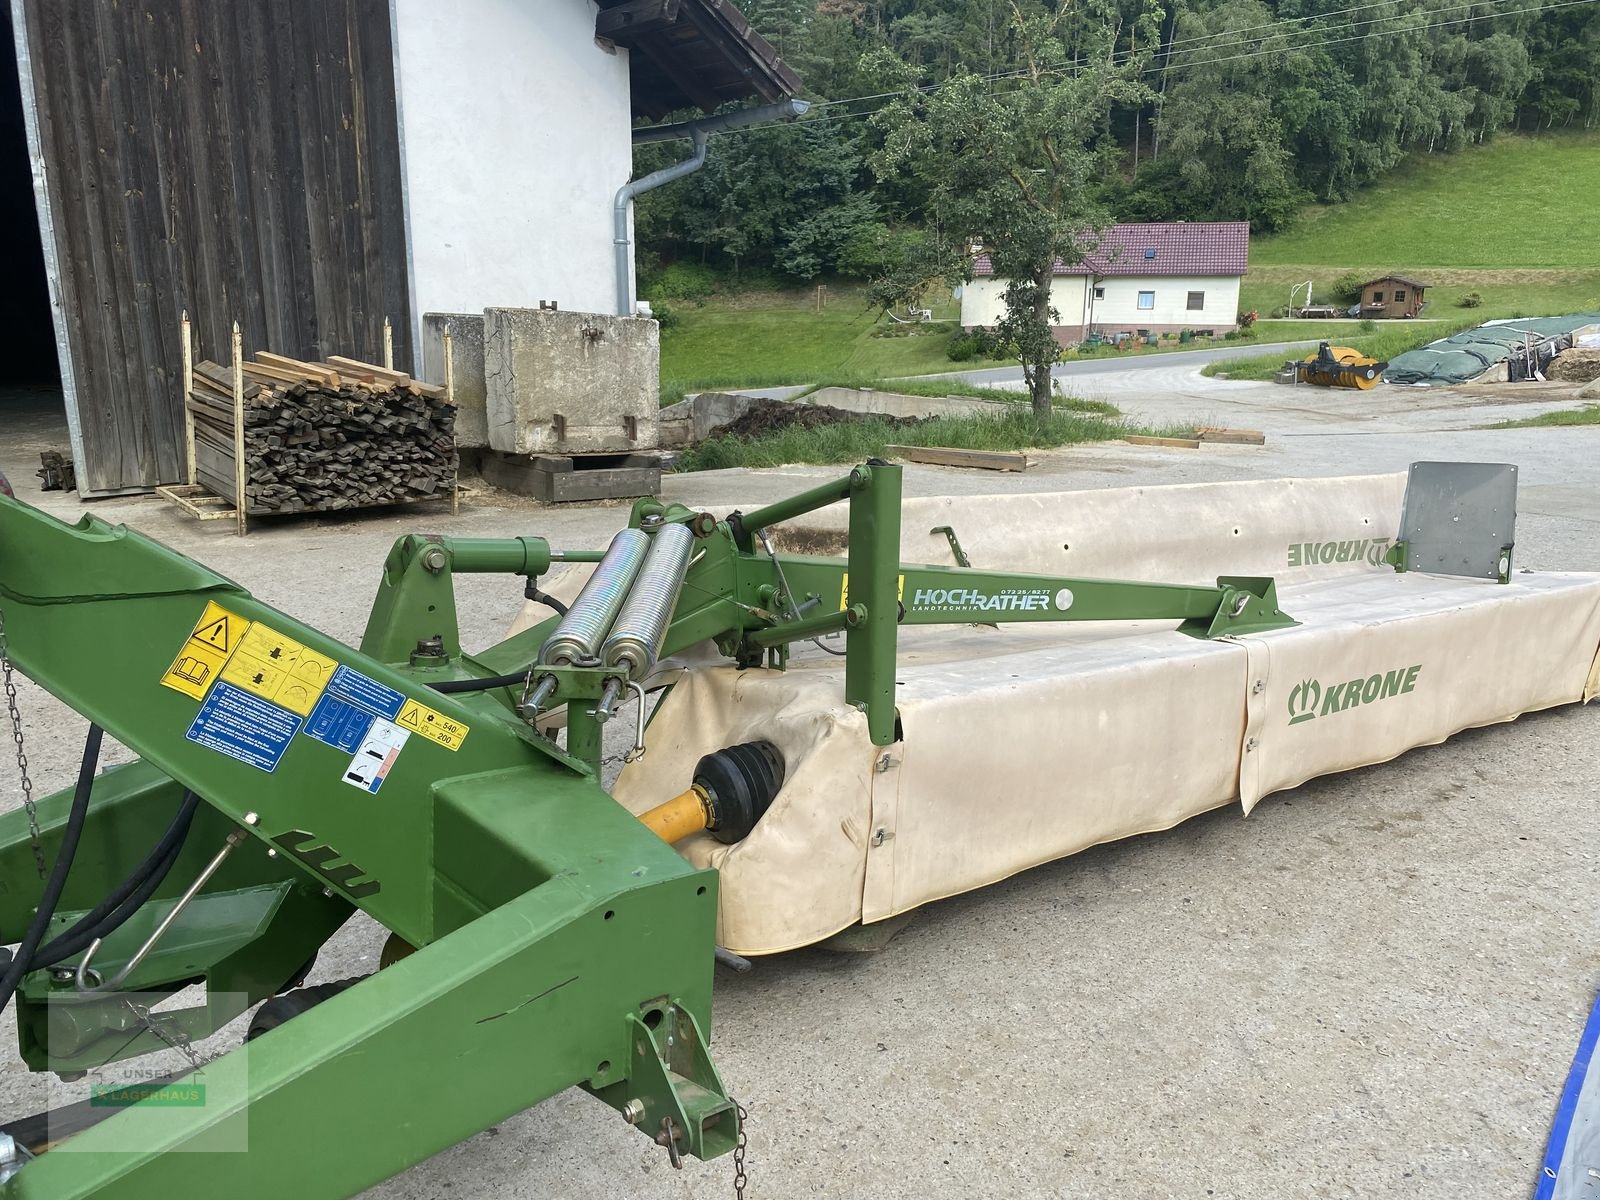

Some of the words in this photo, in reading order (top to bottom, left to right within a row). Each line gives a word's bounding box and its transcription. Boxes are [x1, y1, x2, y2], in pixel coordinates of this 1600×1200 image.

[1288, 539, 1369, 567] KRONE
[1319, 664, 1423, 717] KRONE
[437, 732, 452, 744] 200
